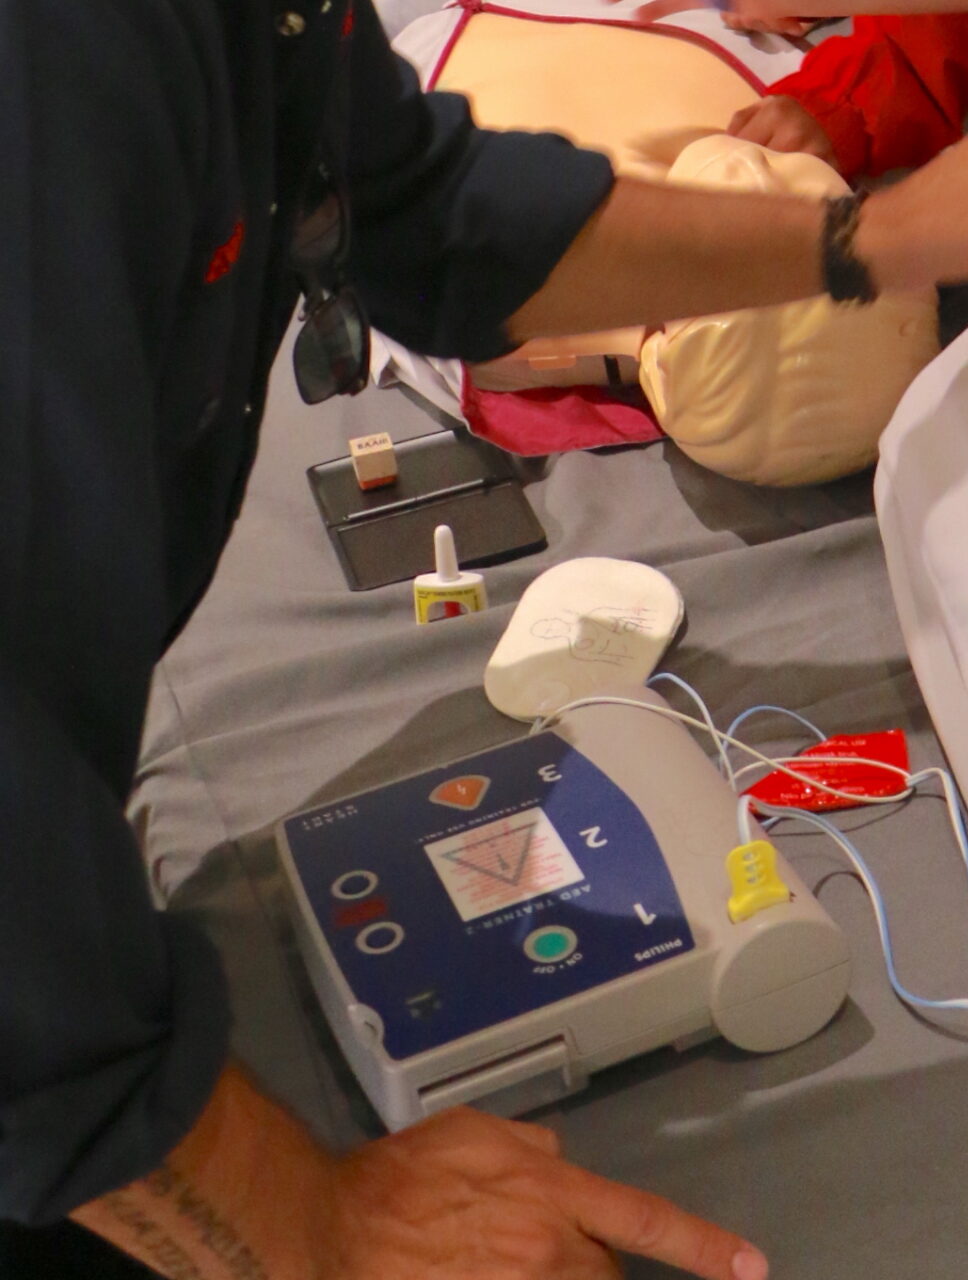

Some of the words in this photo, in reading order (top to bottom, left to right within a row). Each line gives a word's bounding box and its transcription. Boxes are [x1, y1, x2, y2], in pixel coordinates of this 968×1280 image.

[537, 764, 563, 782] 3
[579, 825, 609, 849] 2
[559, 884, 592, 902] AED
[633, 902, 657, 926] 1
[634, 937, 684, 962] PHILIPS
[566, 952, 584, 967] ON
[532, 965, 557, 974] OFF
